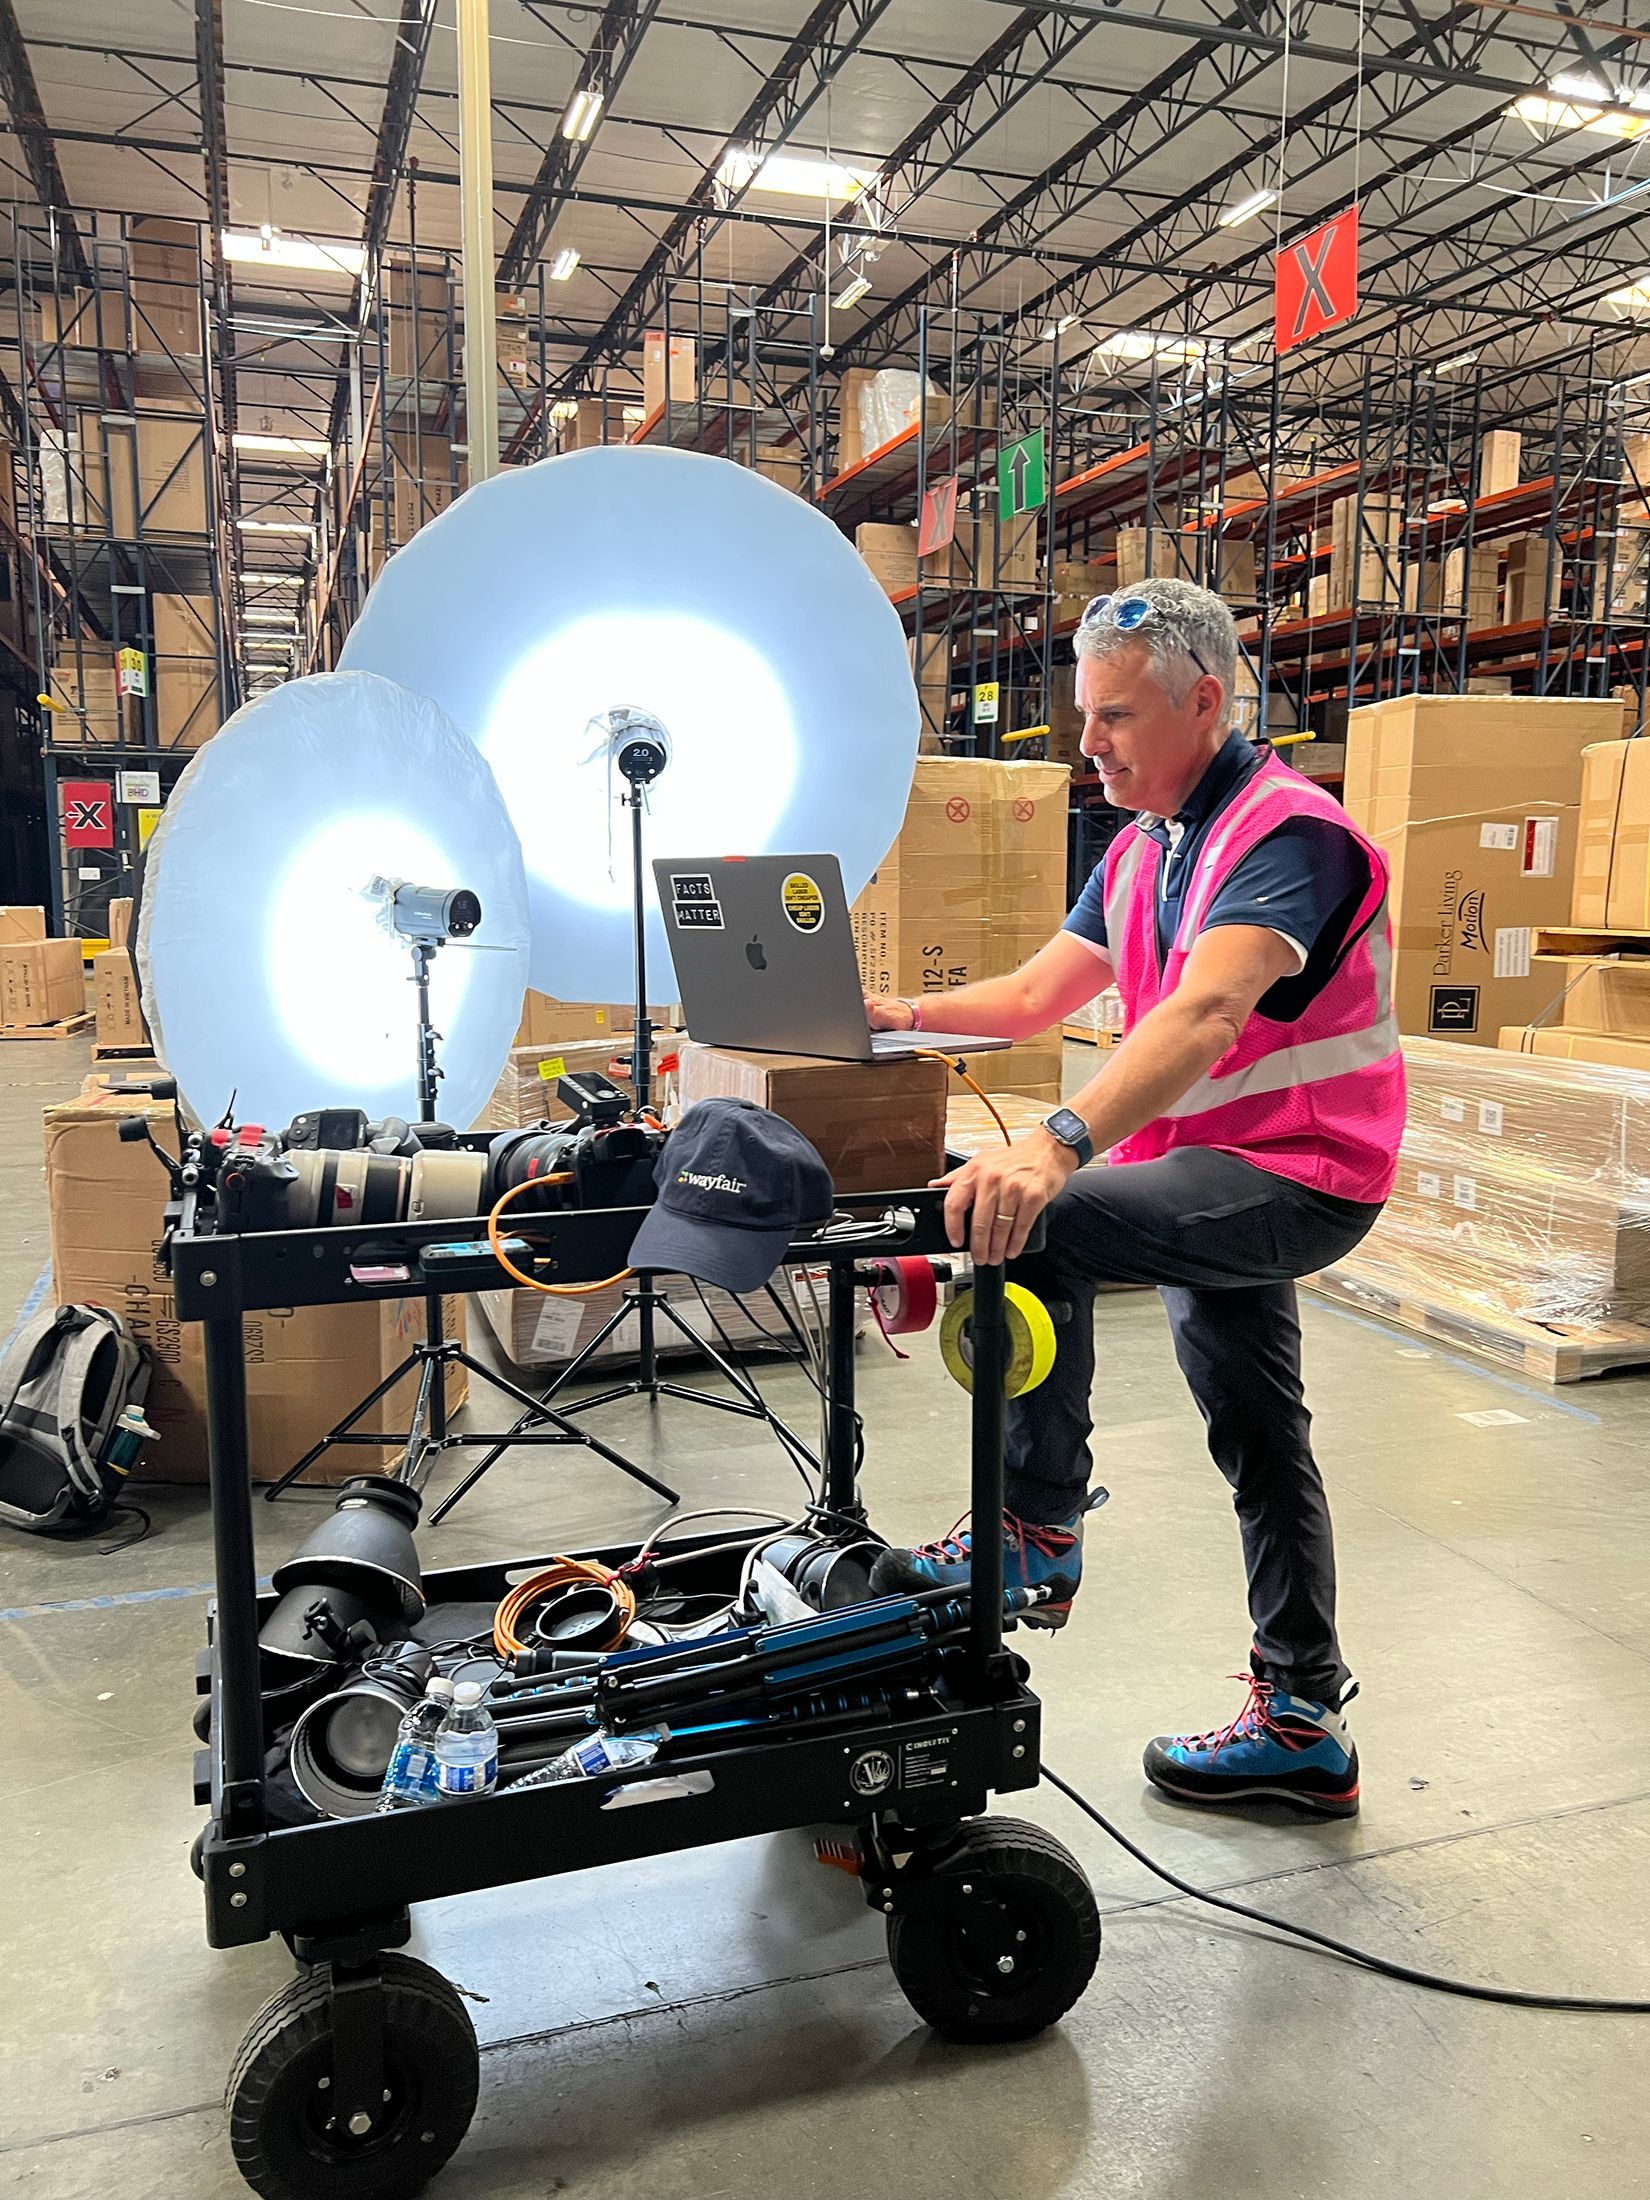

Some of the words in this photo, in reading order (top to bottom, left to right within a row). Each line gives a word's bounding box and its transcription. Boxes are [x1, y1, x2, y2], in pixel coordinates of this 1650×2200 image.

[979, 691, 994, 702] 28
[127, 788, 149, 798] BHD
[675, 883, 711, 895] FACTS
[1437, 869, 1463, 916] Living
[677, 909, 721, 920] MATTER
[1460, 896, 1480, 950] Motion
[1432, 922, 1452, 976] Parker
[688, 1173, 747, 1193] wayfair
[156, 1320, 181, 1364] GS2900
